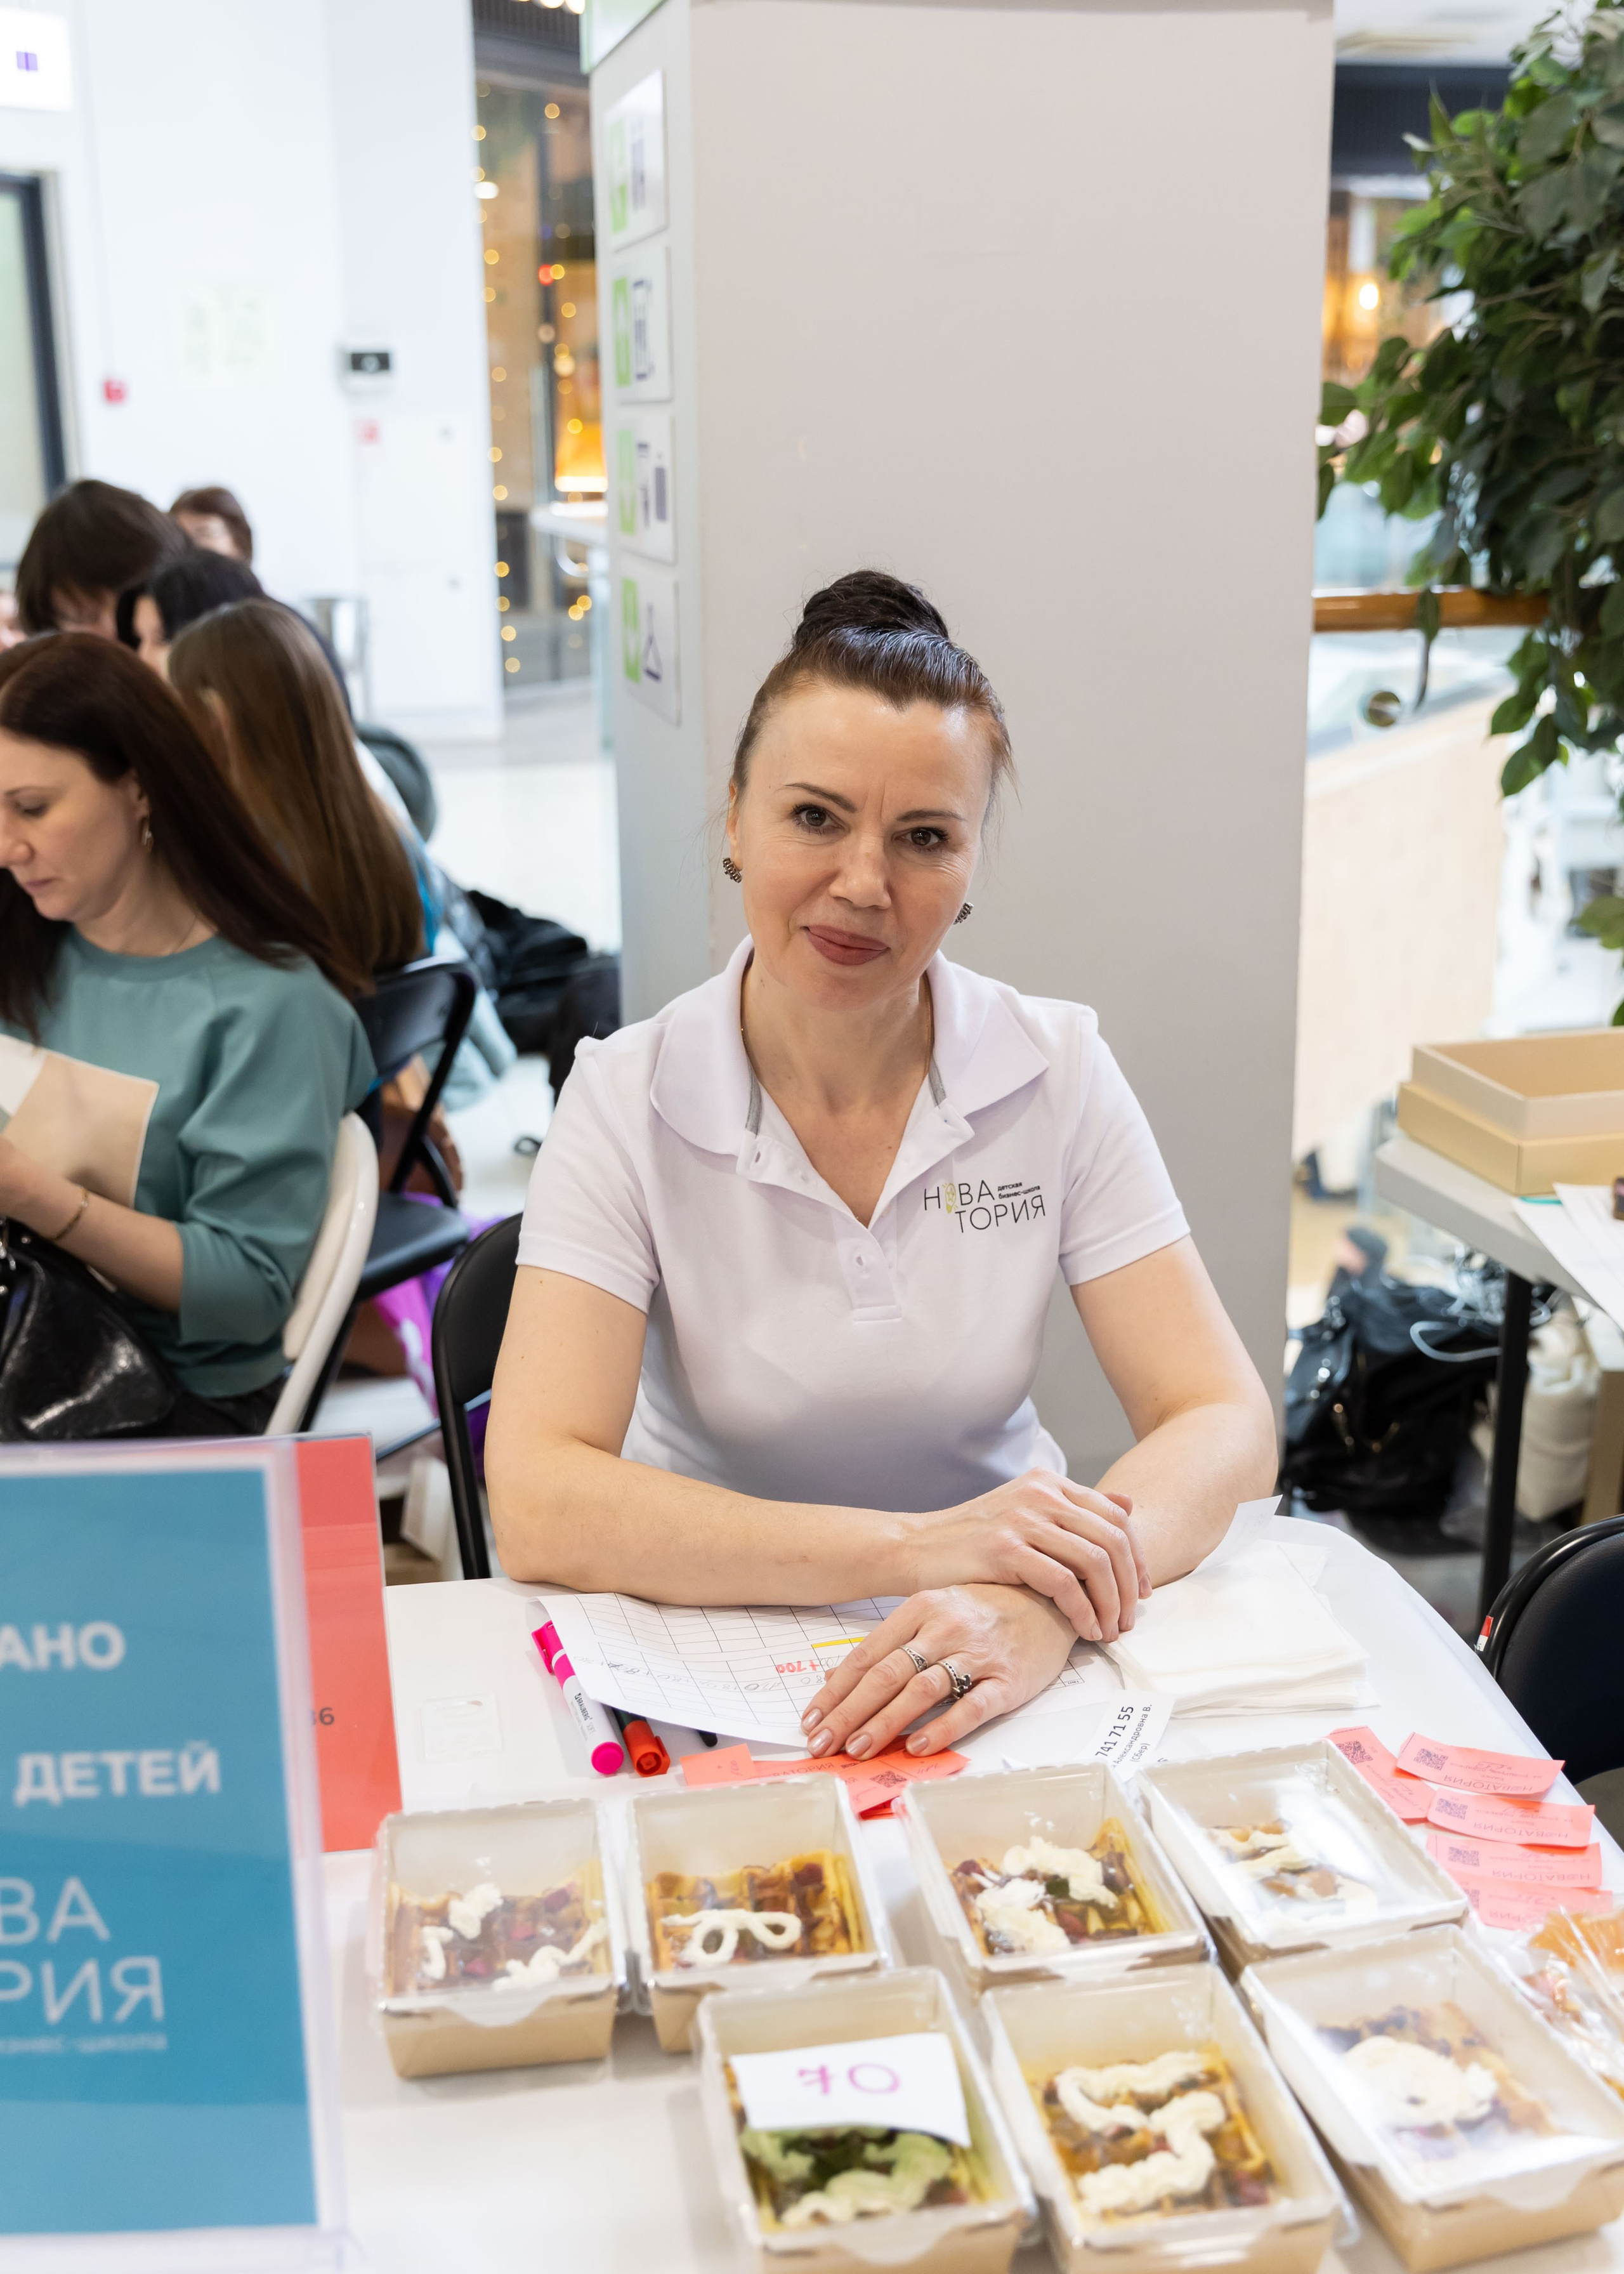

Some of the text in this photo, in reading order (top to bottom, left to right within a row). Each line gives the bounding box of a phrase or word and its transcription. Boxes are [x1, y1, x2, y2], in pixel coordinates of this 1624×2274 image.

[997, 1181, 1023, 1192] детская
[999, 1185, 1041, 1199] бизнес-школа
[955, 1195, 1046, 1233] ТОРИЯ
[576, 1697, 591, 1721] BRAUBERG
[1095, 1706, 1134, 1757] 741 71 55
[1114, 1704, 1152, 1764] Александровна В.
[1129, 1742, 1151, 1763] (Сбер)
[13, 1740, 222, 1807] ДЕТЕЙ
